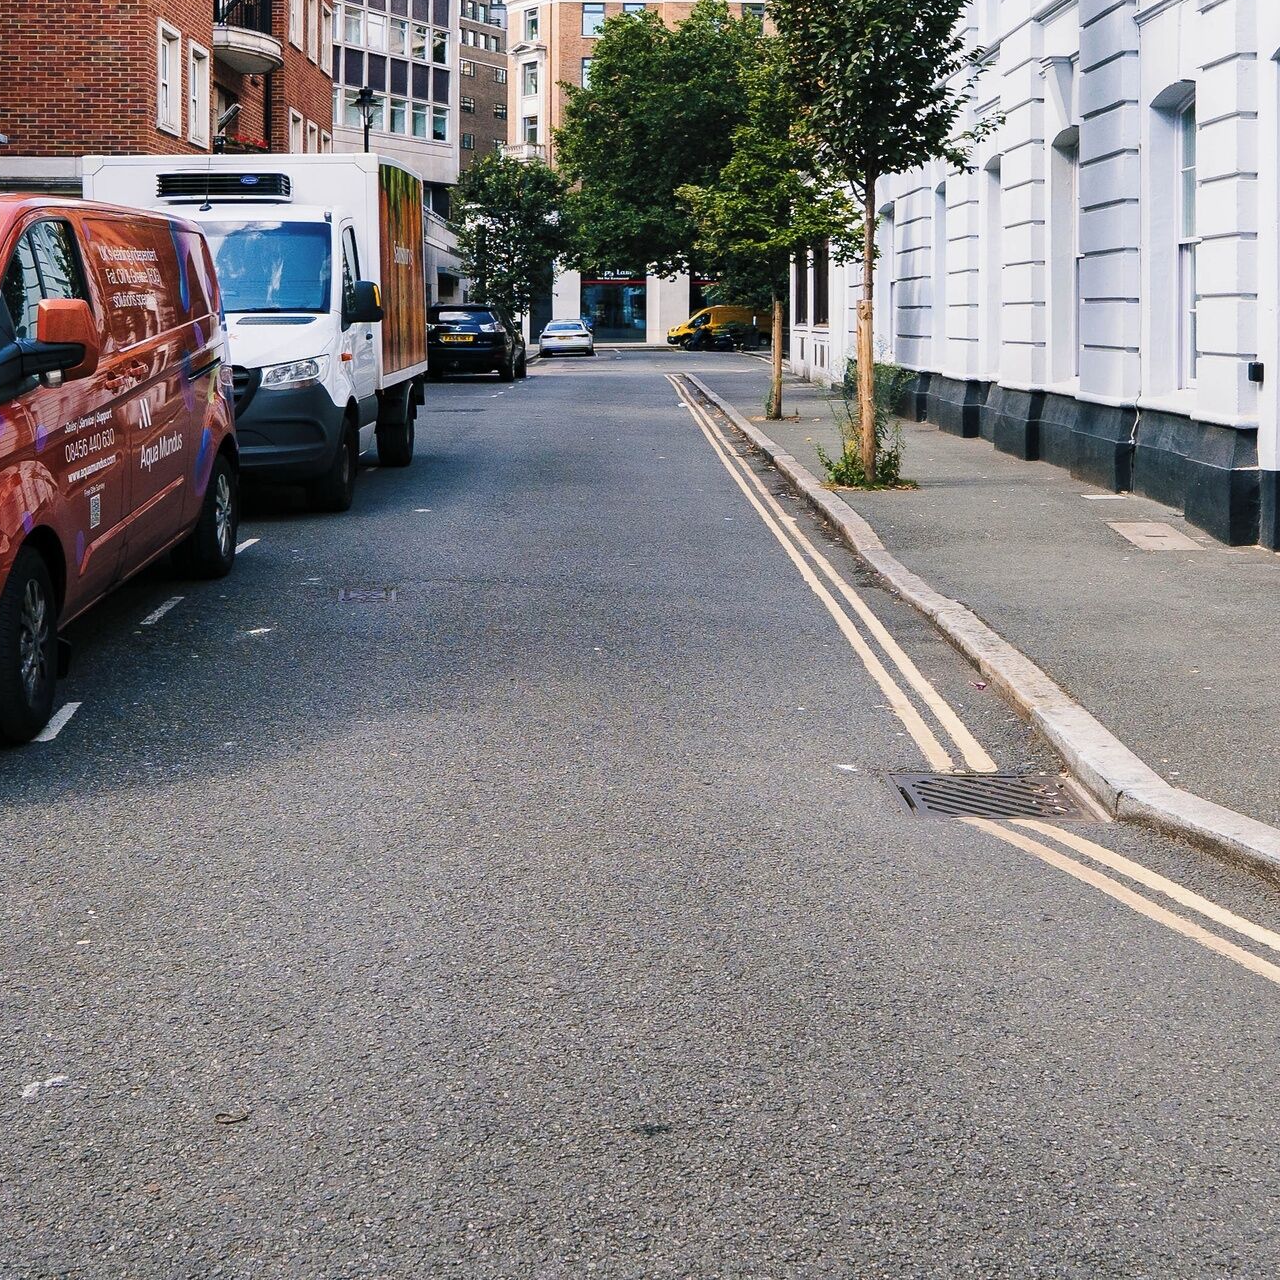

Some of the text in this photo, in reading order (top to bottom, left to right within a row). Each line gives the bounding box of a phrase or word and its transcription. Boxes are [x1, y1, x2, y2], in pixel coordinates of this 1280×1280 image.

[65, 408, 113, 433] Sales Service Support
[65, 428, 115, 463] 08456 440 630
[140, 430, 183, 472] Aqua Mundus
